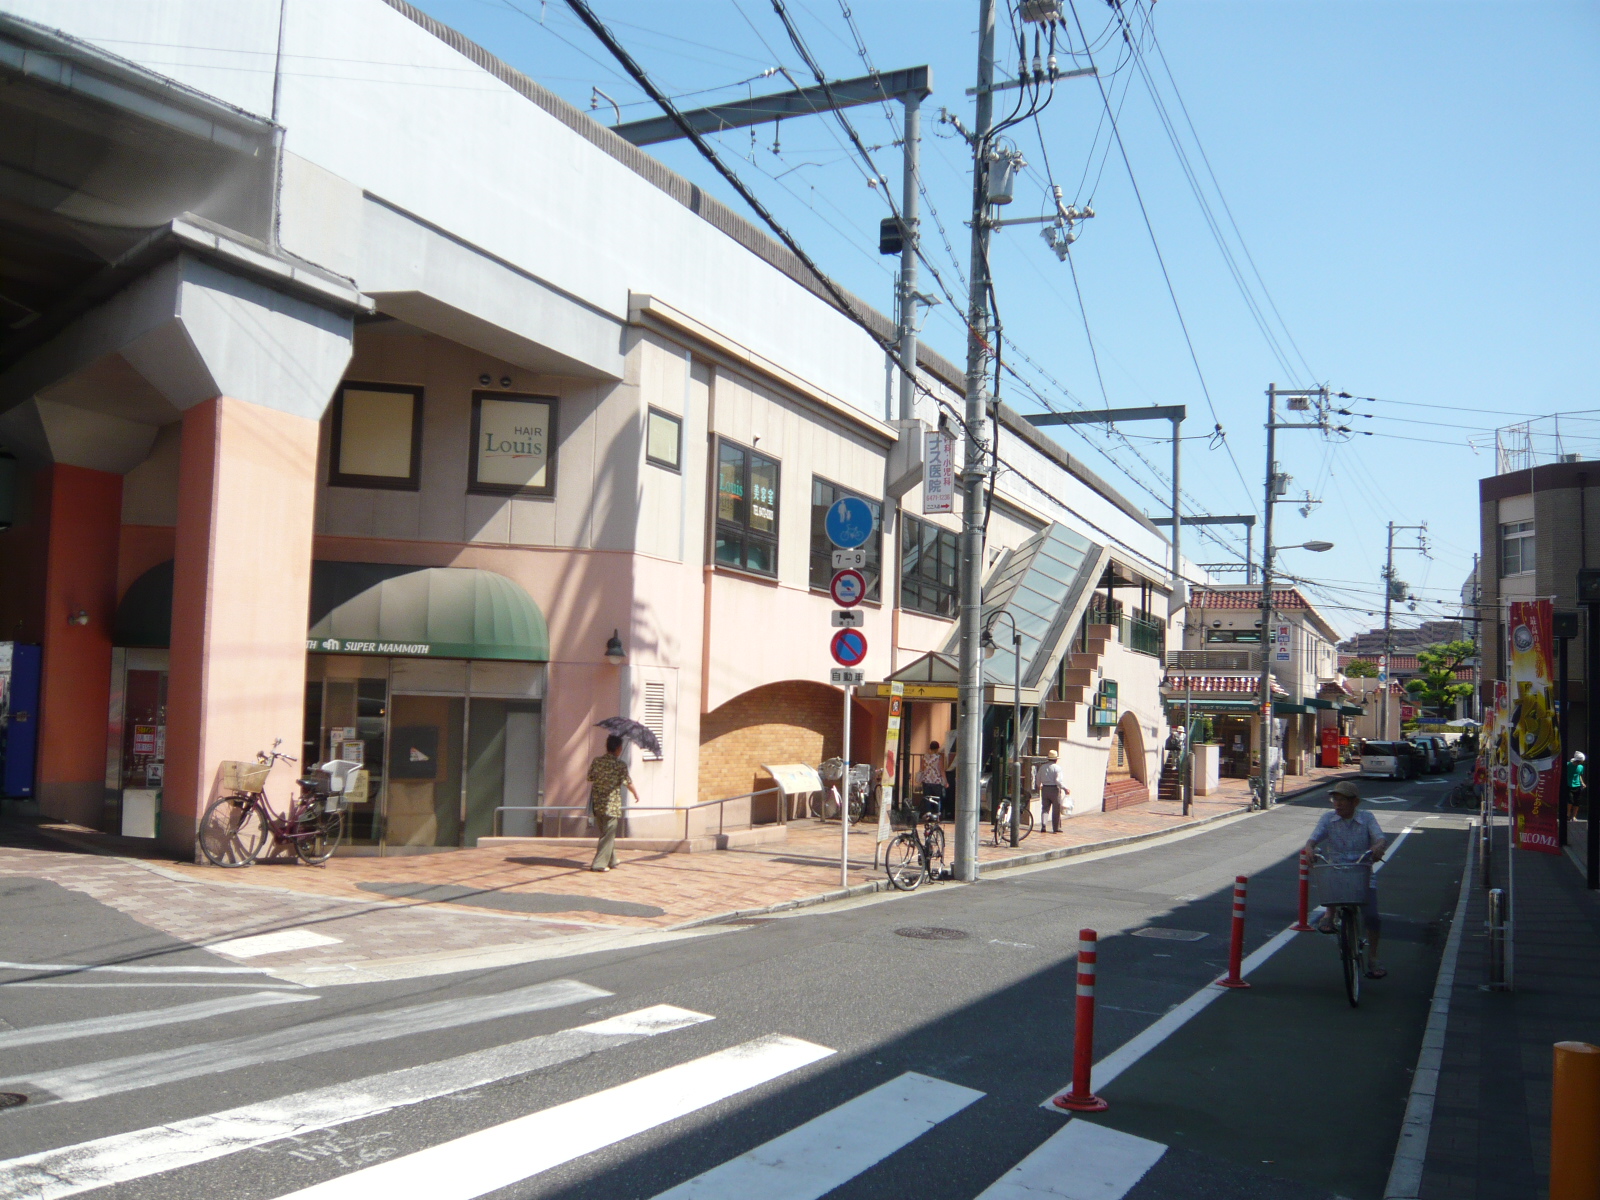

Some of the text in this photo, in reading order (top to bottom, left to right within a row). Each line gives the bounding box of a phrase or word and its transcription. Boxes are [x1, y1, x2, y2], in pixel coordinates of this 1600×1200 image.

[514, 426, 542, 436] HAIR
[485, 432, 542, 455] Louis
[719, 473, 744, 497] Louis
[344, 641, 376, 652] SUPER
[377, 642, 430, 654] MAMMOTH
[832, 671, 864, 682] 自動車
